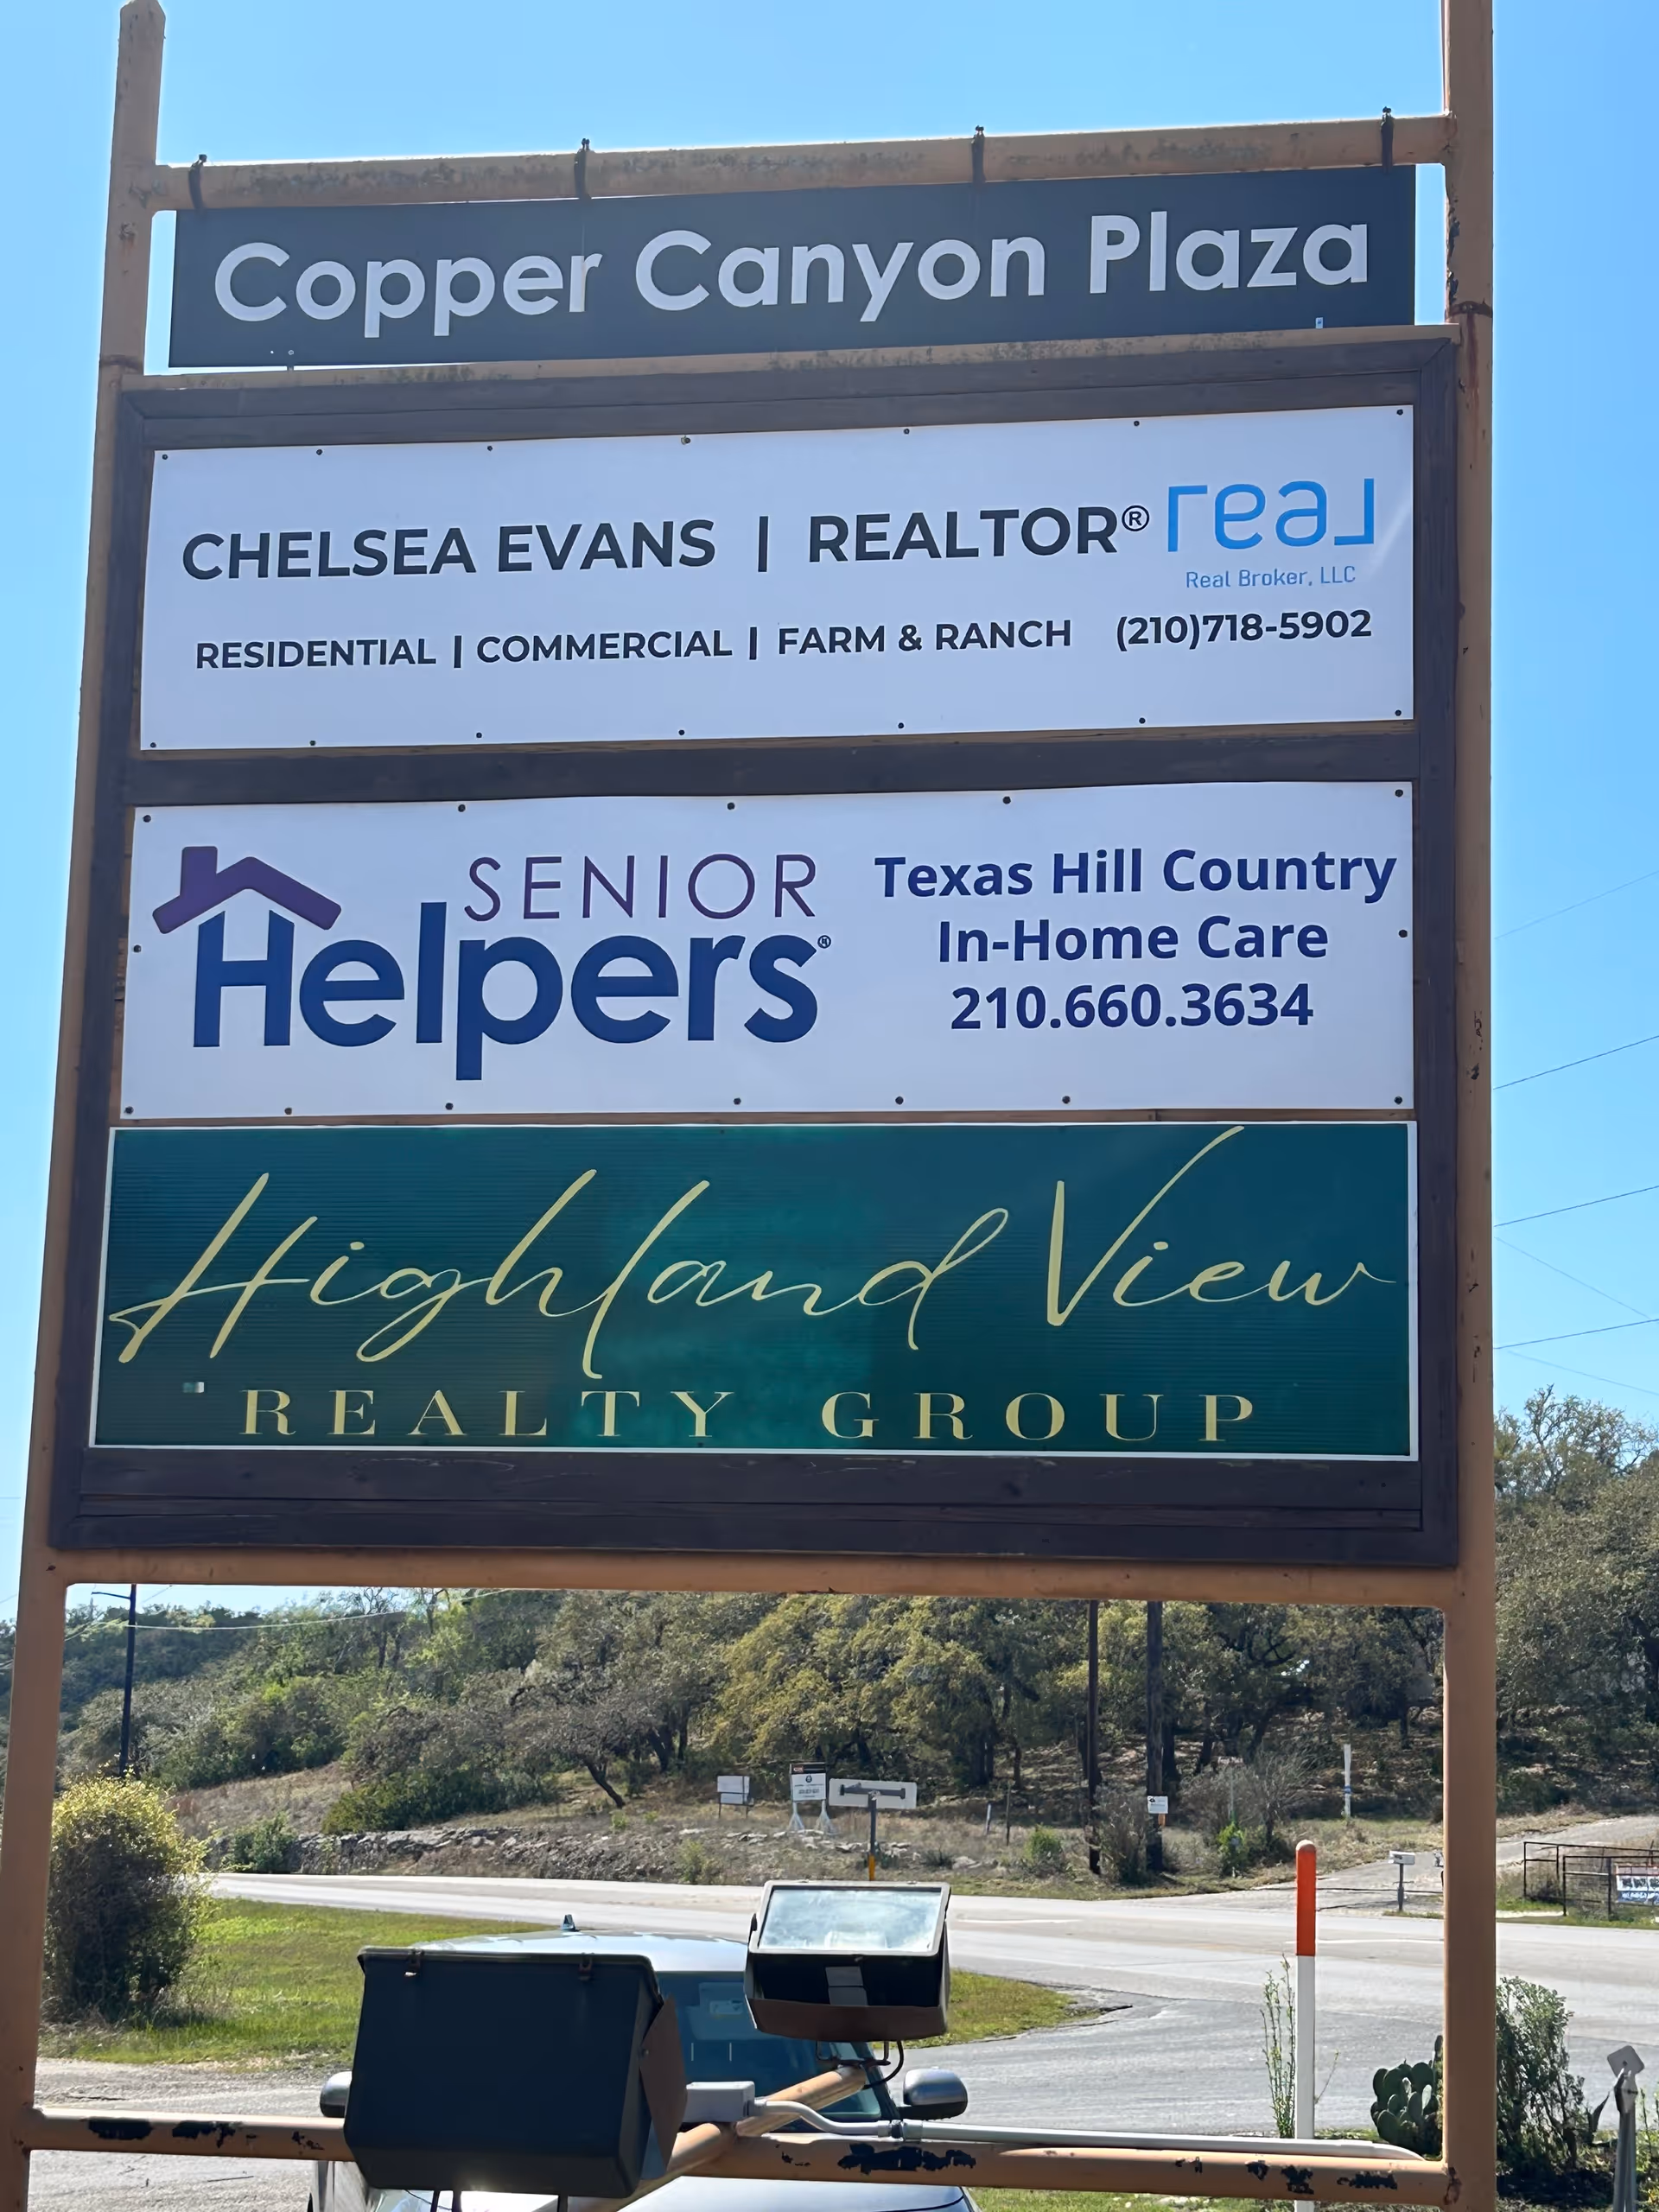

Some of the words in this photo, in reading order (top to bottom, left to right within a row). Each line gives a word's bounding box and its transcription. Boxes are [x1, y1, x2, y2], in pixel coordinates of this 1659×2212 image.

[214, 242, 603, 339] Copper
[635, 230, 1046, 323] Canyon
[1090, 211, 1368, 295] Plaza
[1167, 478, 1375, 552] real
[182, 527, 477, 580] CHELSEA
[498, 519, 716, 573] EVANS
[1185, 570, 1231, 588] Real
[1238, 567, 1313, 588] Broker,
[1320, 565, 1356, 584] LLC
[196, 638, 437, 669] RESIDENTIAL
[476, 630, 734, 663] COMMERCIAL
[778, 623, 886, 654] FARM
[898, 624, 922, 652] &
[935, 620, 1071, 651] RANCH
[1116, 609, 1372, 652] (210)718-5902
[464, 854, 817, 922] SENIOR
[874, 856, 1033, 898] Texas
[1052, 848, 1142, 894] Hill
[1163, 849, 1396, 904] Country
[938, 918, 1179, 963] In-Home
[1198, 915, 1329, 959] Care
[950, 982, 1314, 1029] 210.660.3634
[110, 1169, 1008, 1379] Highland
[1046, 1125, 1397, 1326] View
[239, 1389, 734, 1438] REALTY
[821, 1391, 1254, 1442] GROUP
